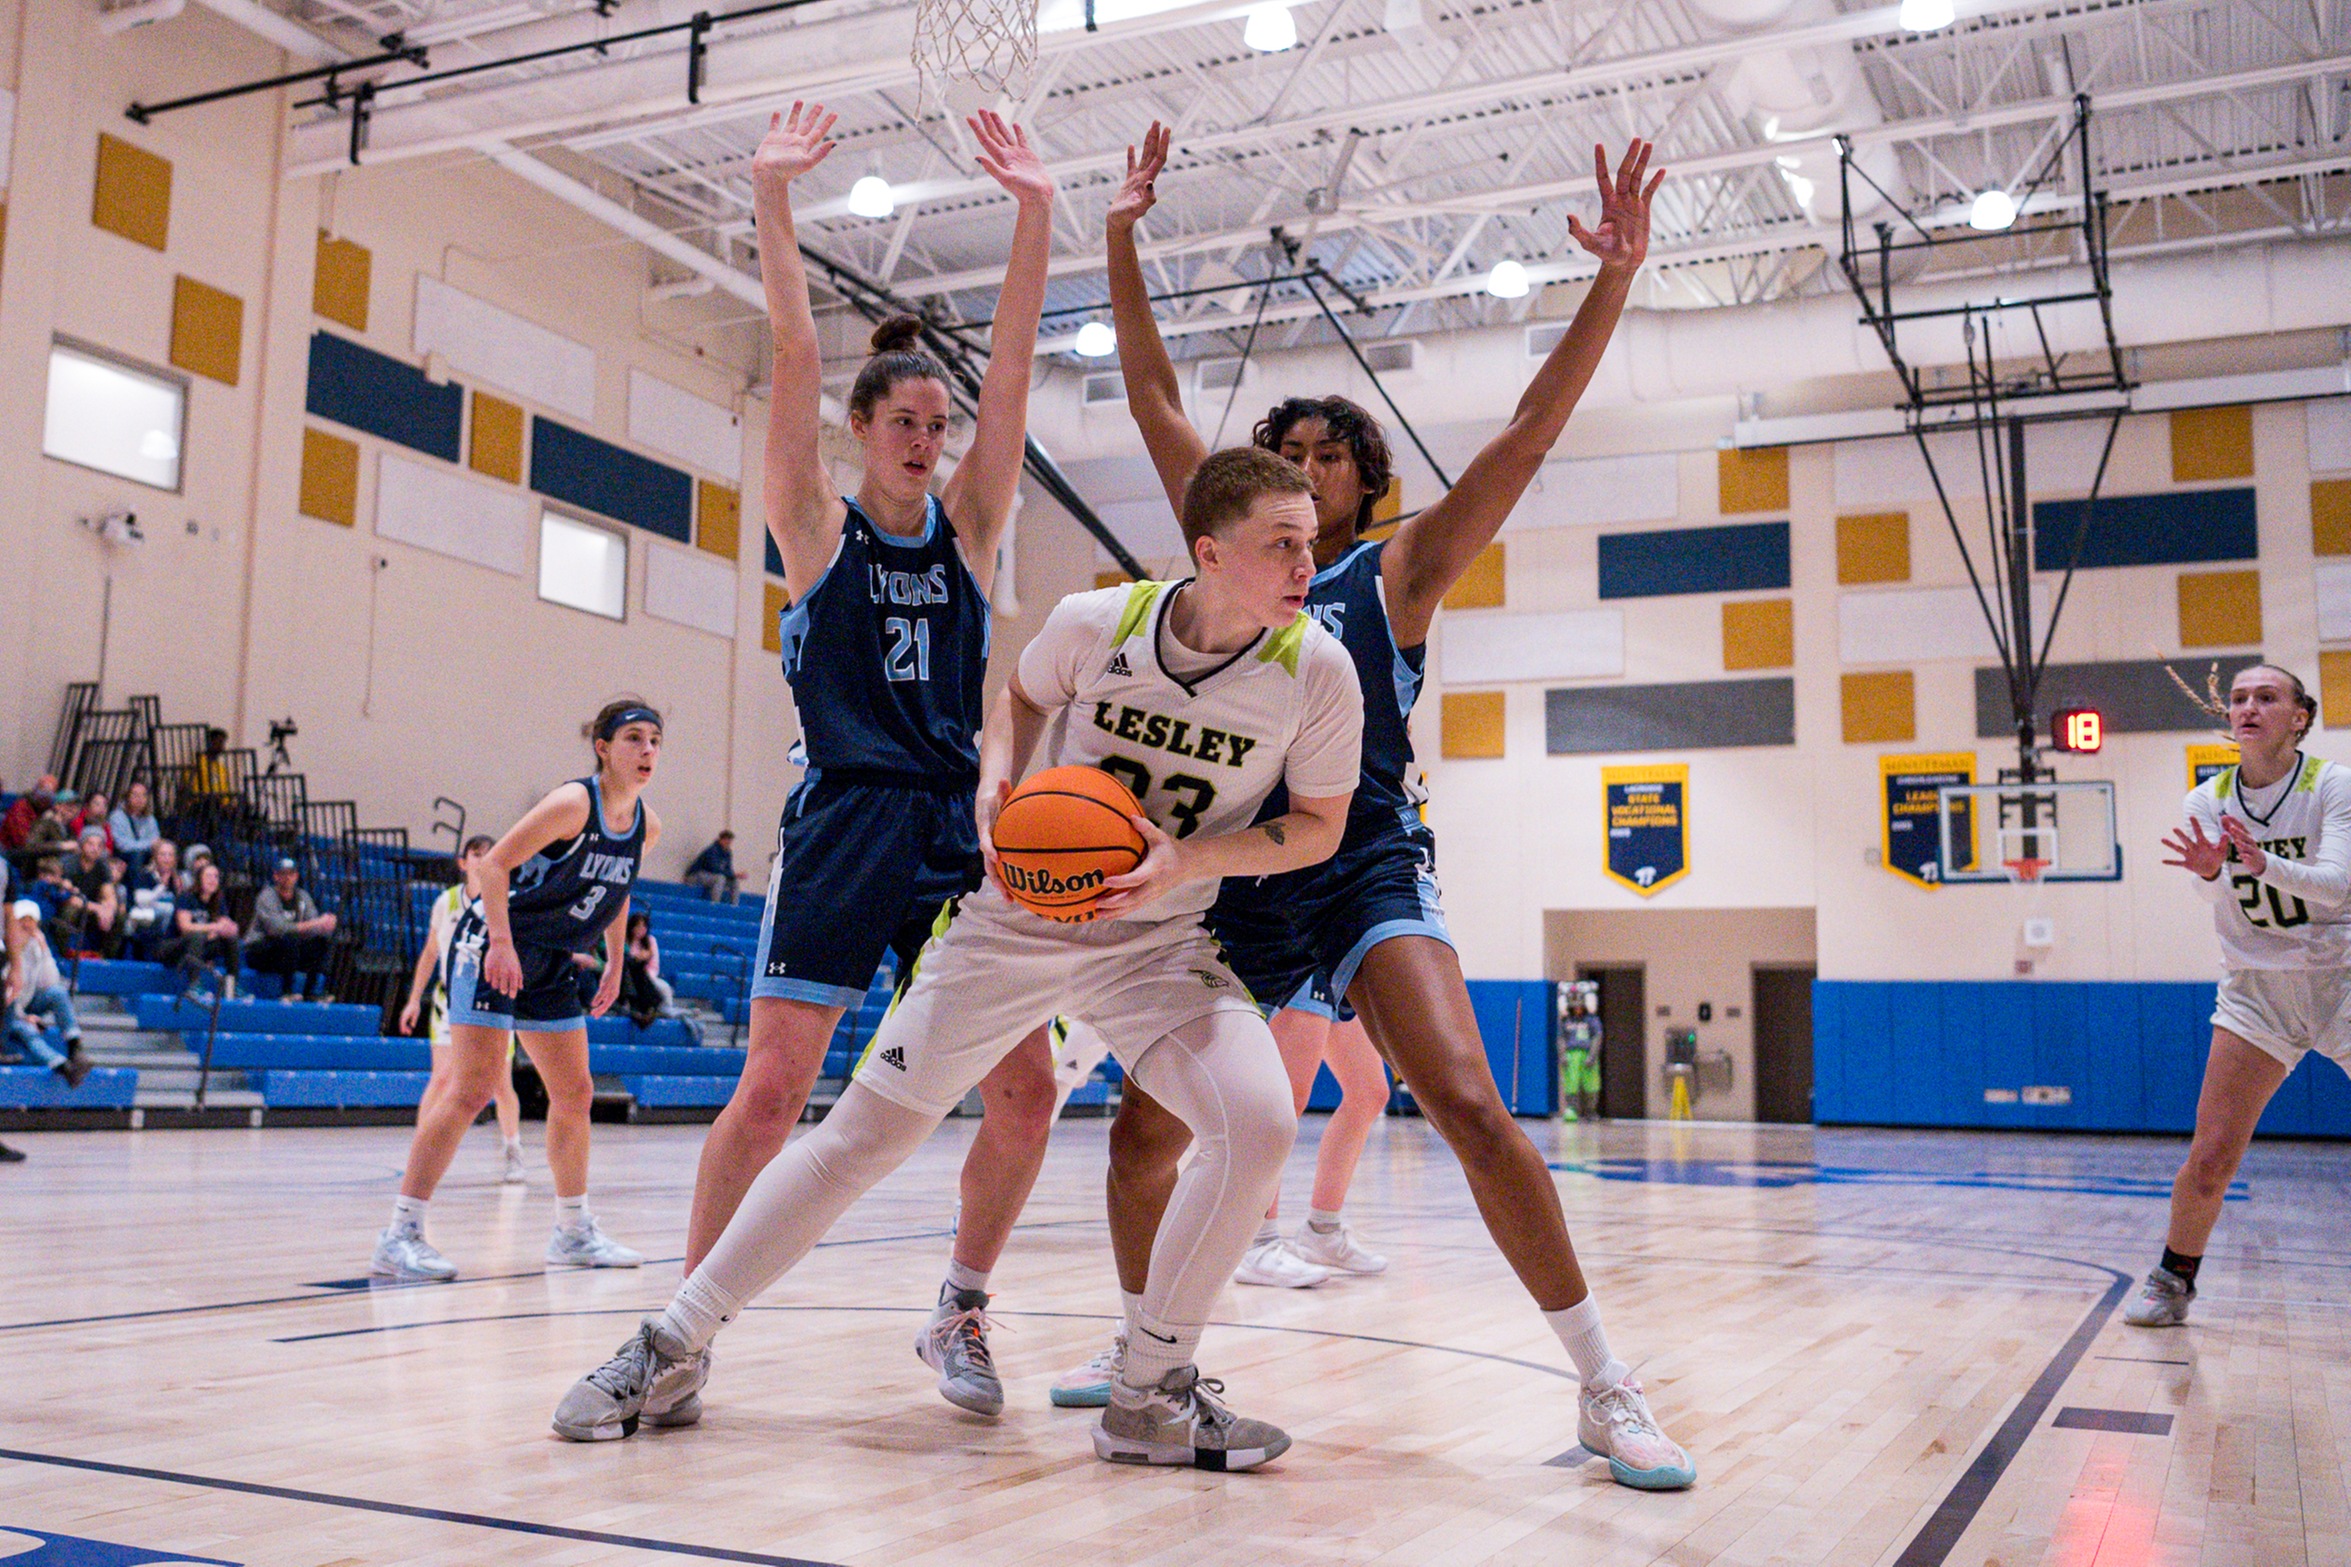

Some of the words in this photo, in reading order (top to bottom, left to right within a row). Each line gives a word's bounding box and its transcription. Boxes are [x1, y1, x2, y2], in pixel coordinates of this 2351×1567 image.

[867, 563, 949, 607] LYONS
[884, 617, 930, 682] 21
[1093, 701, 1256, 767] LESLEY
[2067, 712, 2101, 750] 18
[580, 852, 634, 884] LYONS
[1002, 861, 1105, 894] Wilson
[569, 885, 607, 920] 3
[2232, 874, 2309, 929] 20
